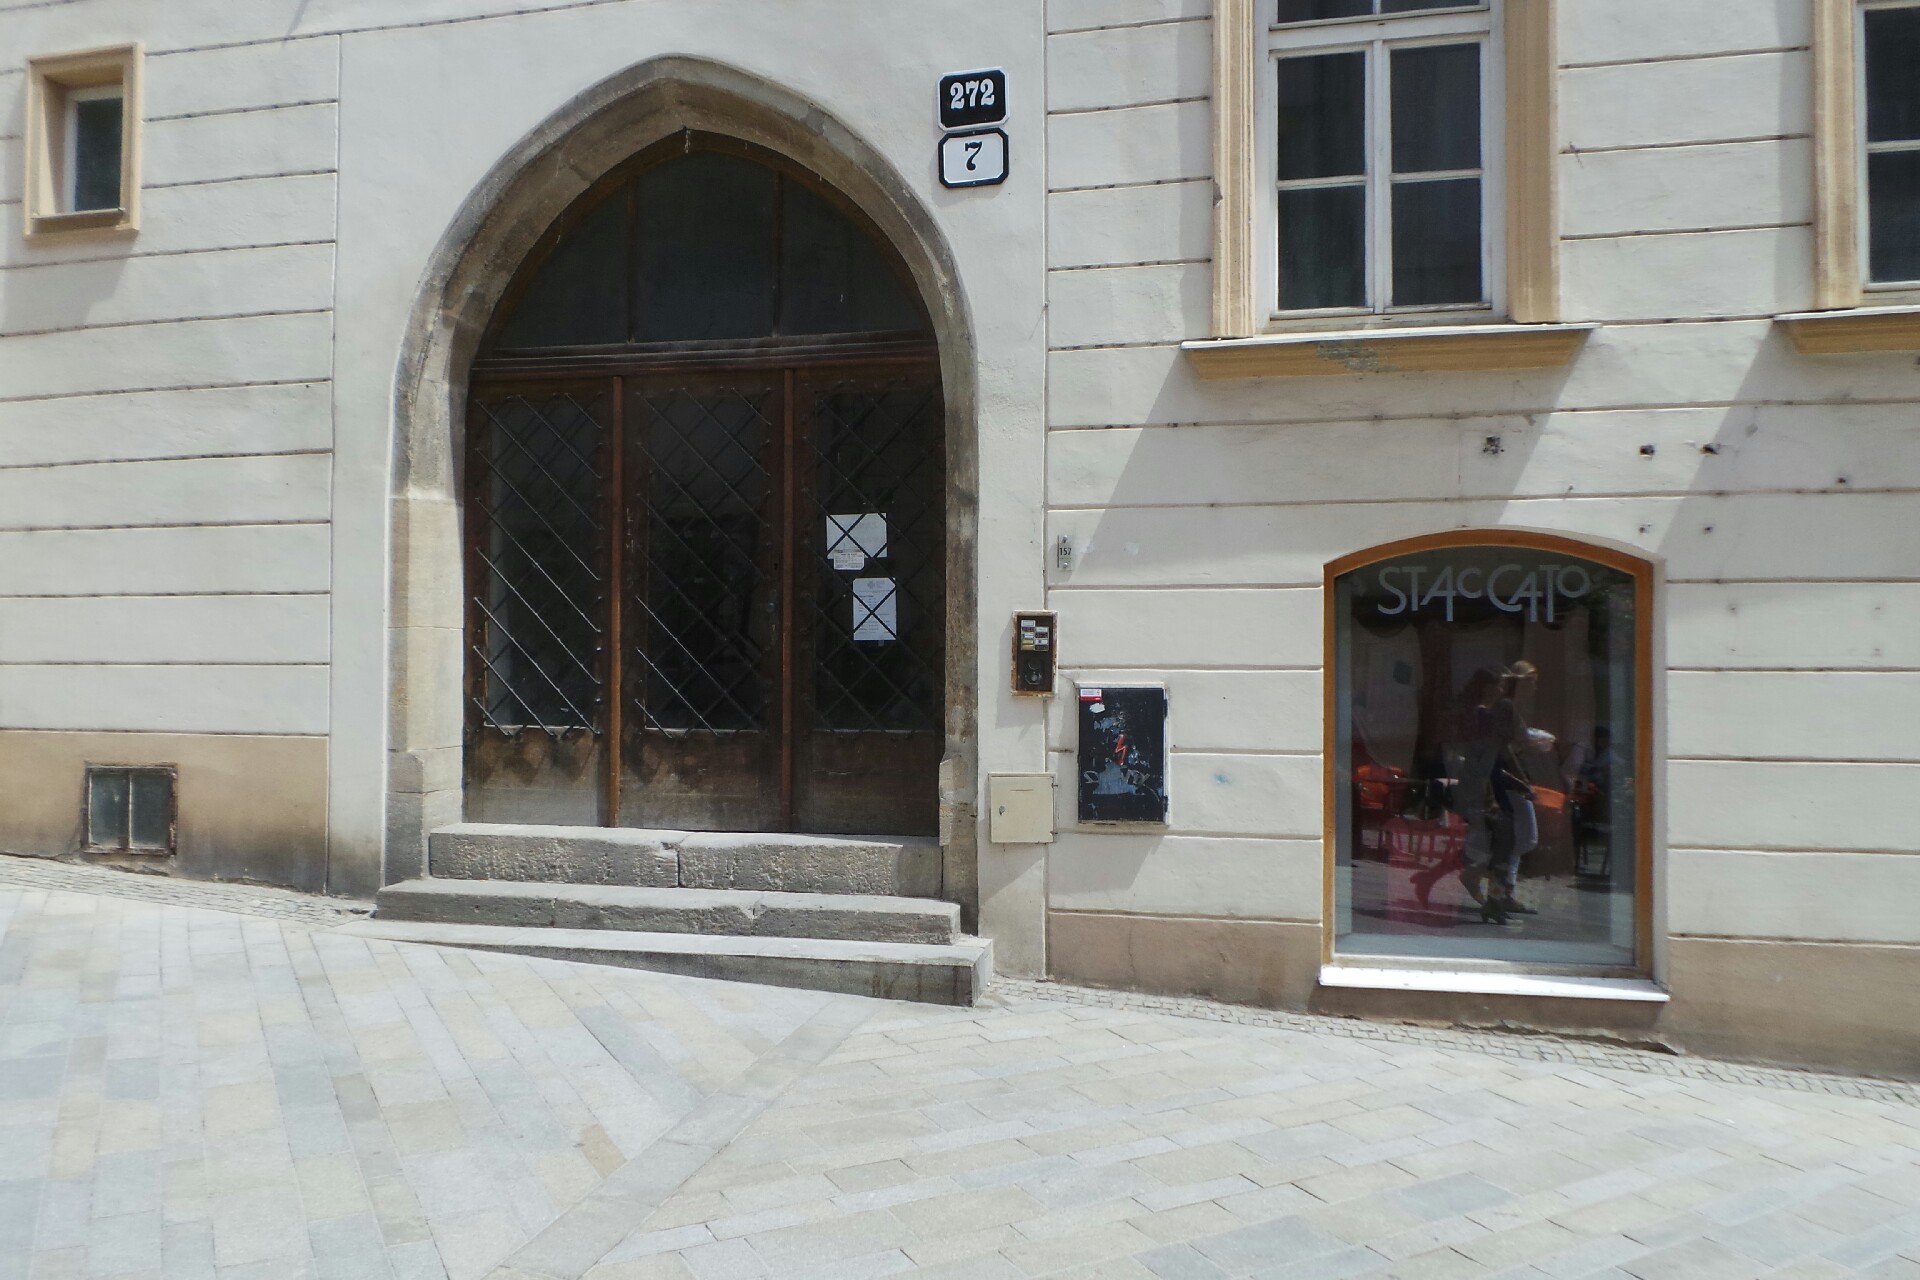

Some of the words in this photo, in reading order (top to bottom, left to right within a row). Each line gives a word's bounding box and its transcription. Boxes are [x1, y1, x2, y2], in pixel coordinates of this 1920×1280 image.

[950, 78, 995, 109] 272
[964, 141, 983, 171] 7
[1059, 547, 1072, 556] 157
[1377, 563, 1590, 622] STACCATO
